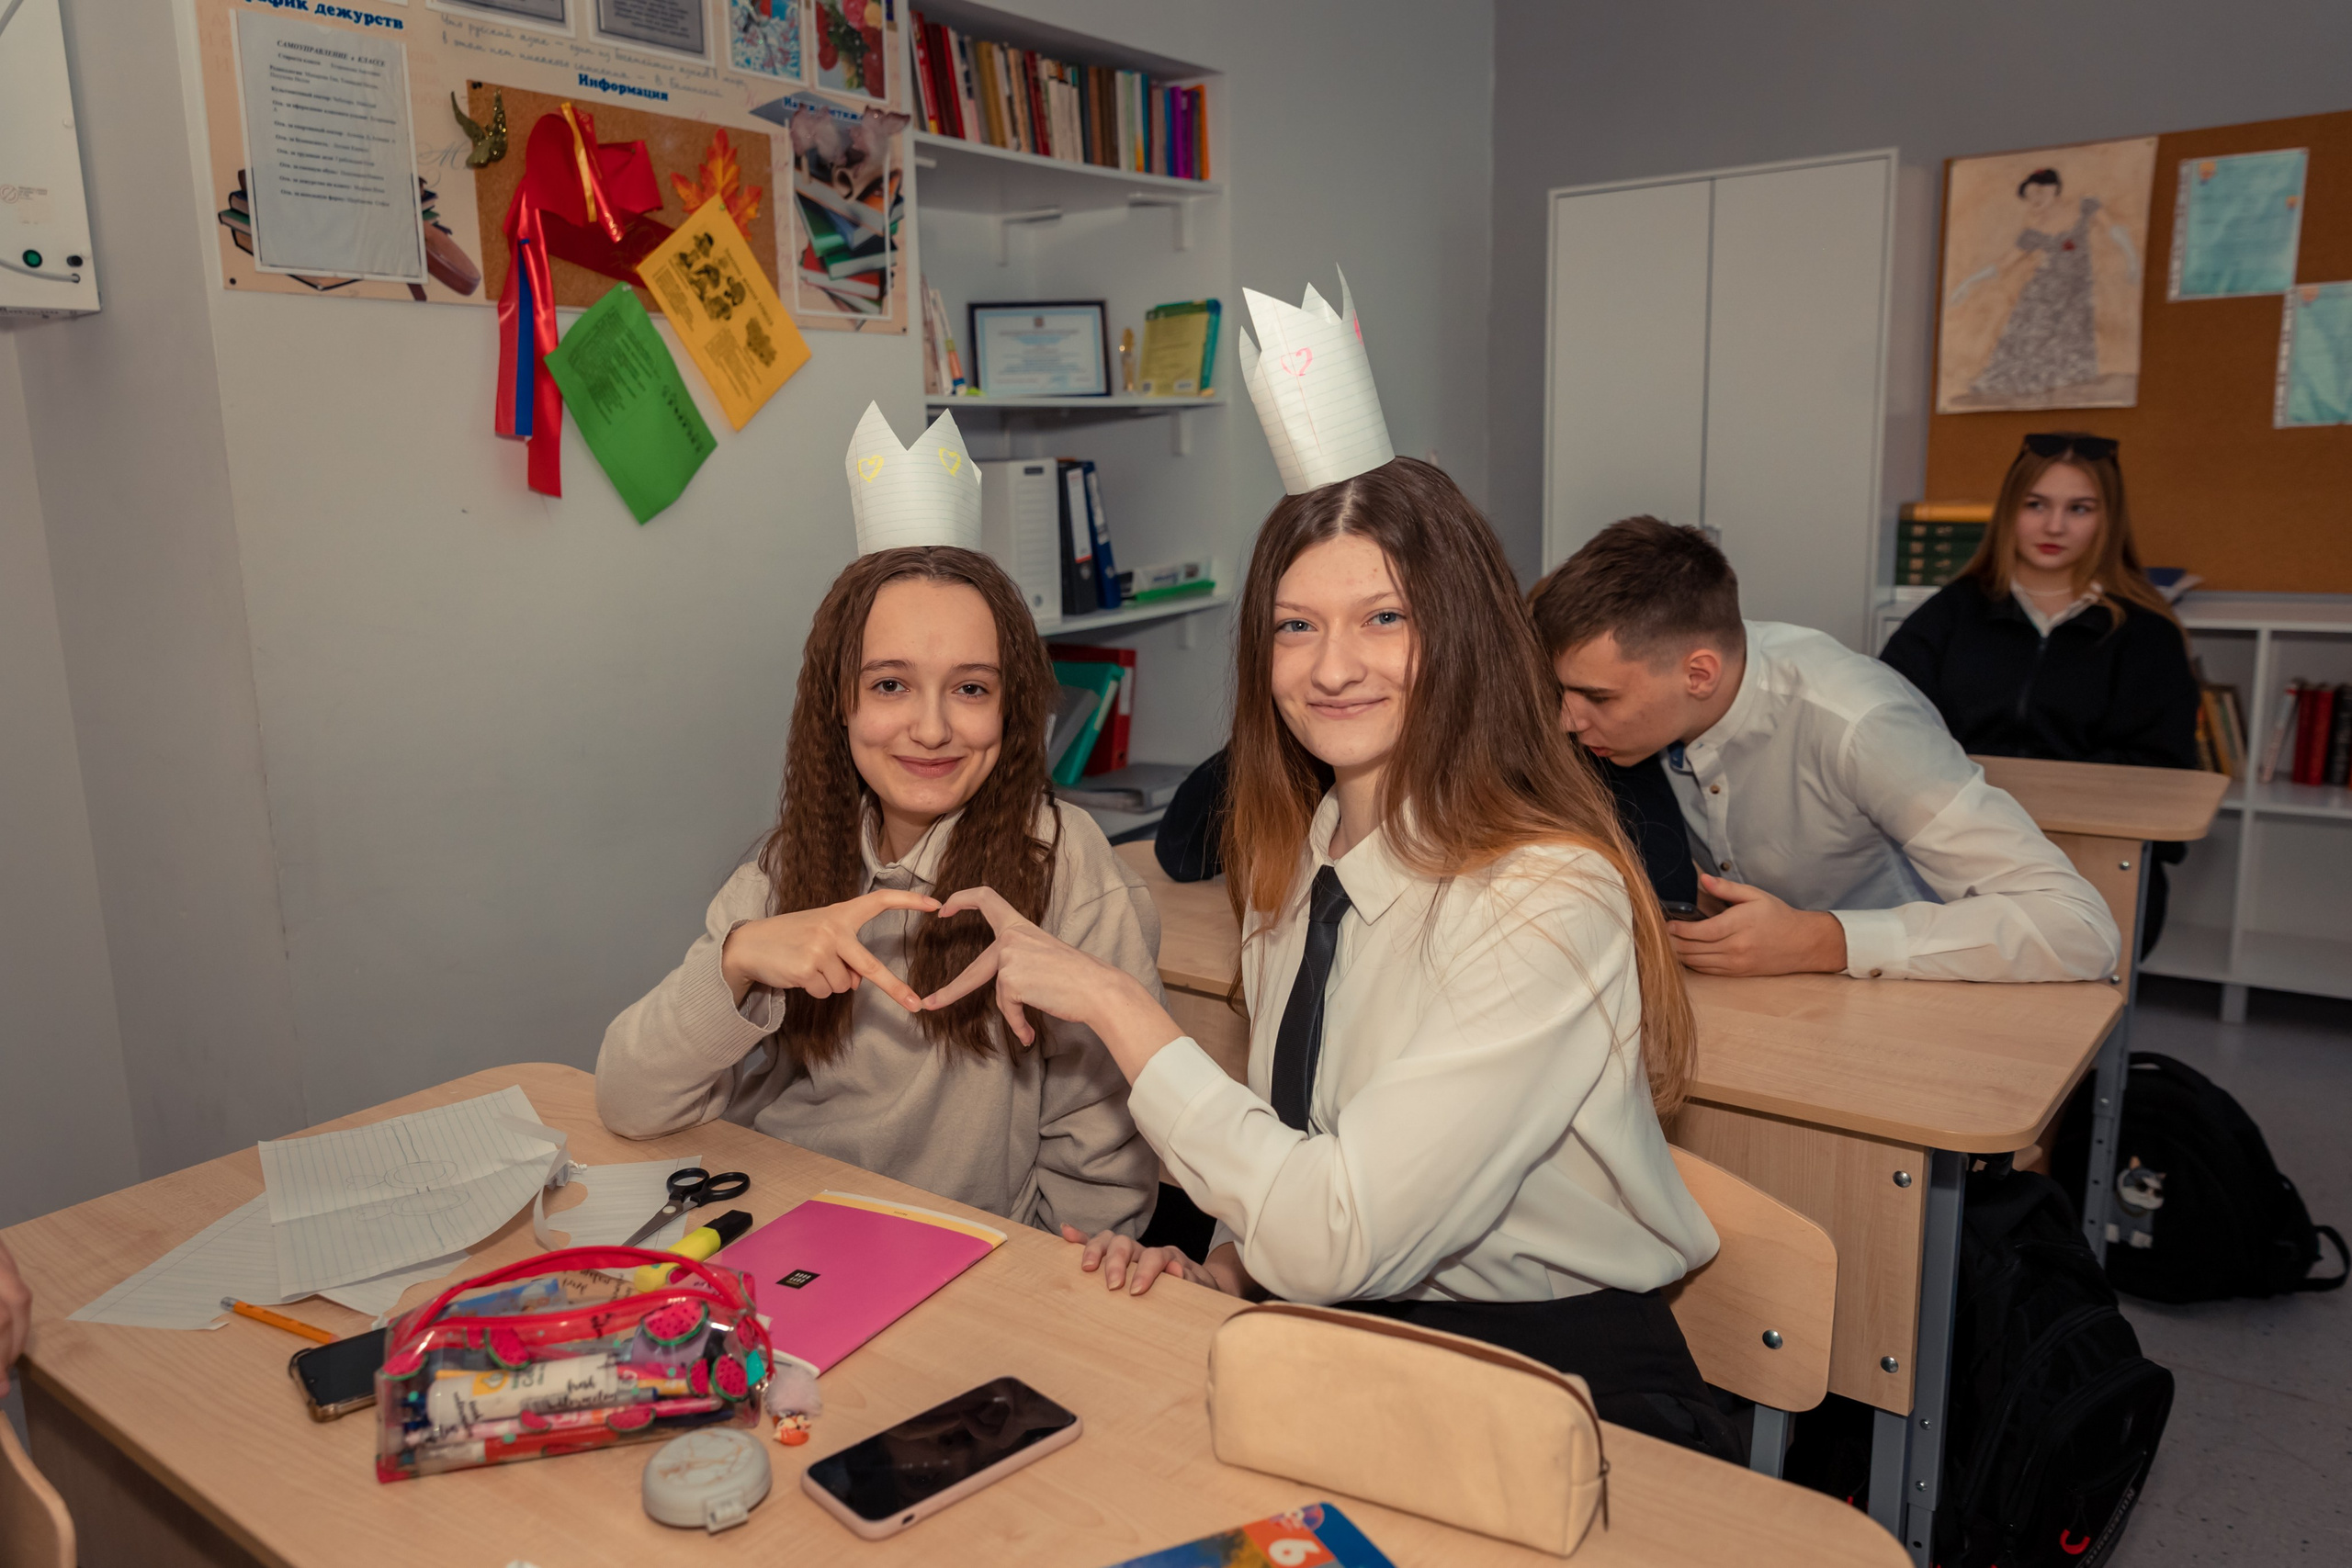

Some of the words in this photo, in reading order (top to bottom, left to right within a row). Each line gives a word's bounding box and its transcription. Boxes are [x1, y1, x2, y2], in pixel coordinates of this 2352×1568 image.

[314, 3, 404, 30] дежурств
[277, 39, 348, 60] САМОУПРАВЛЕНИЕ
[578, 73, 669, 101] Информация
